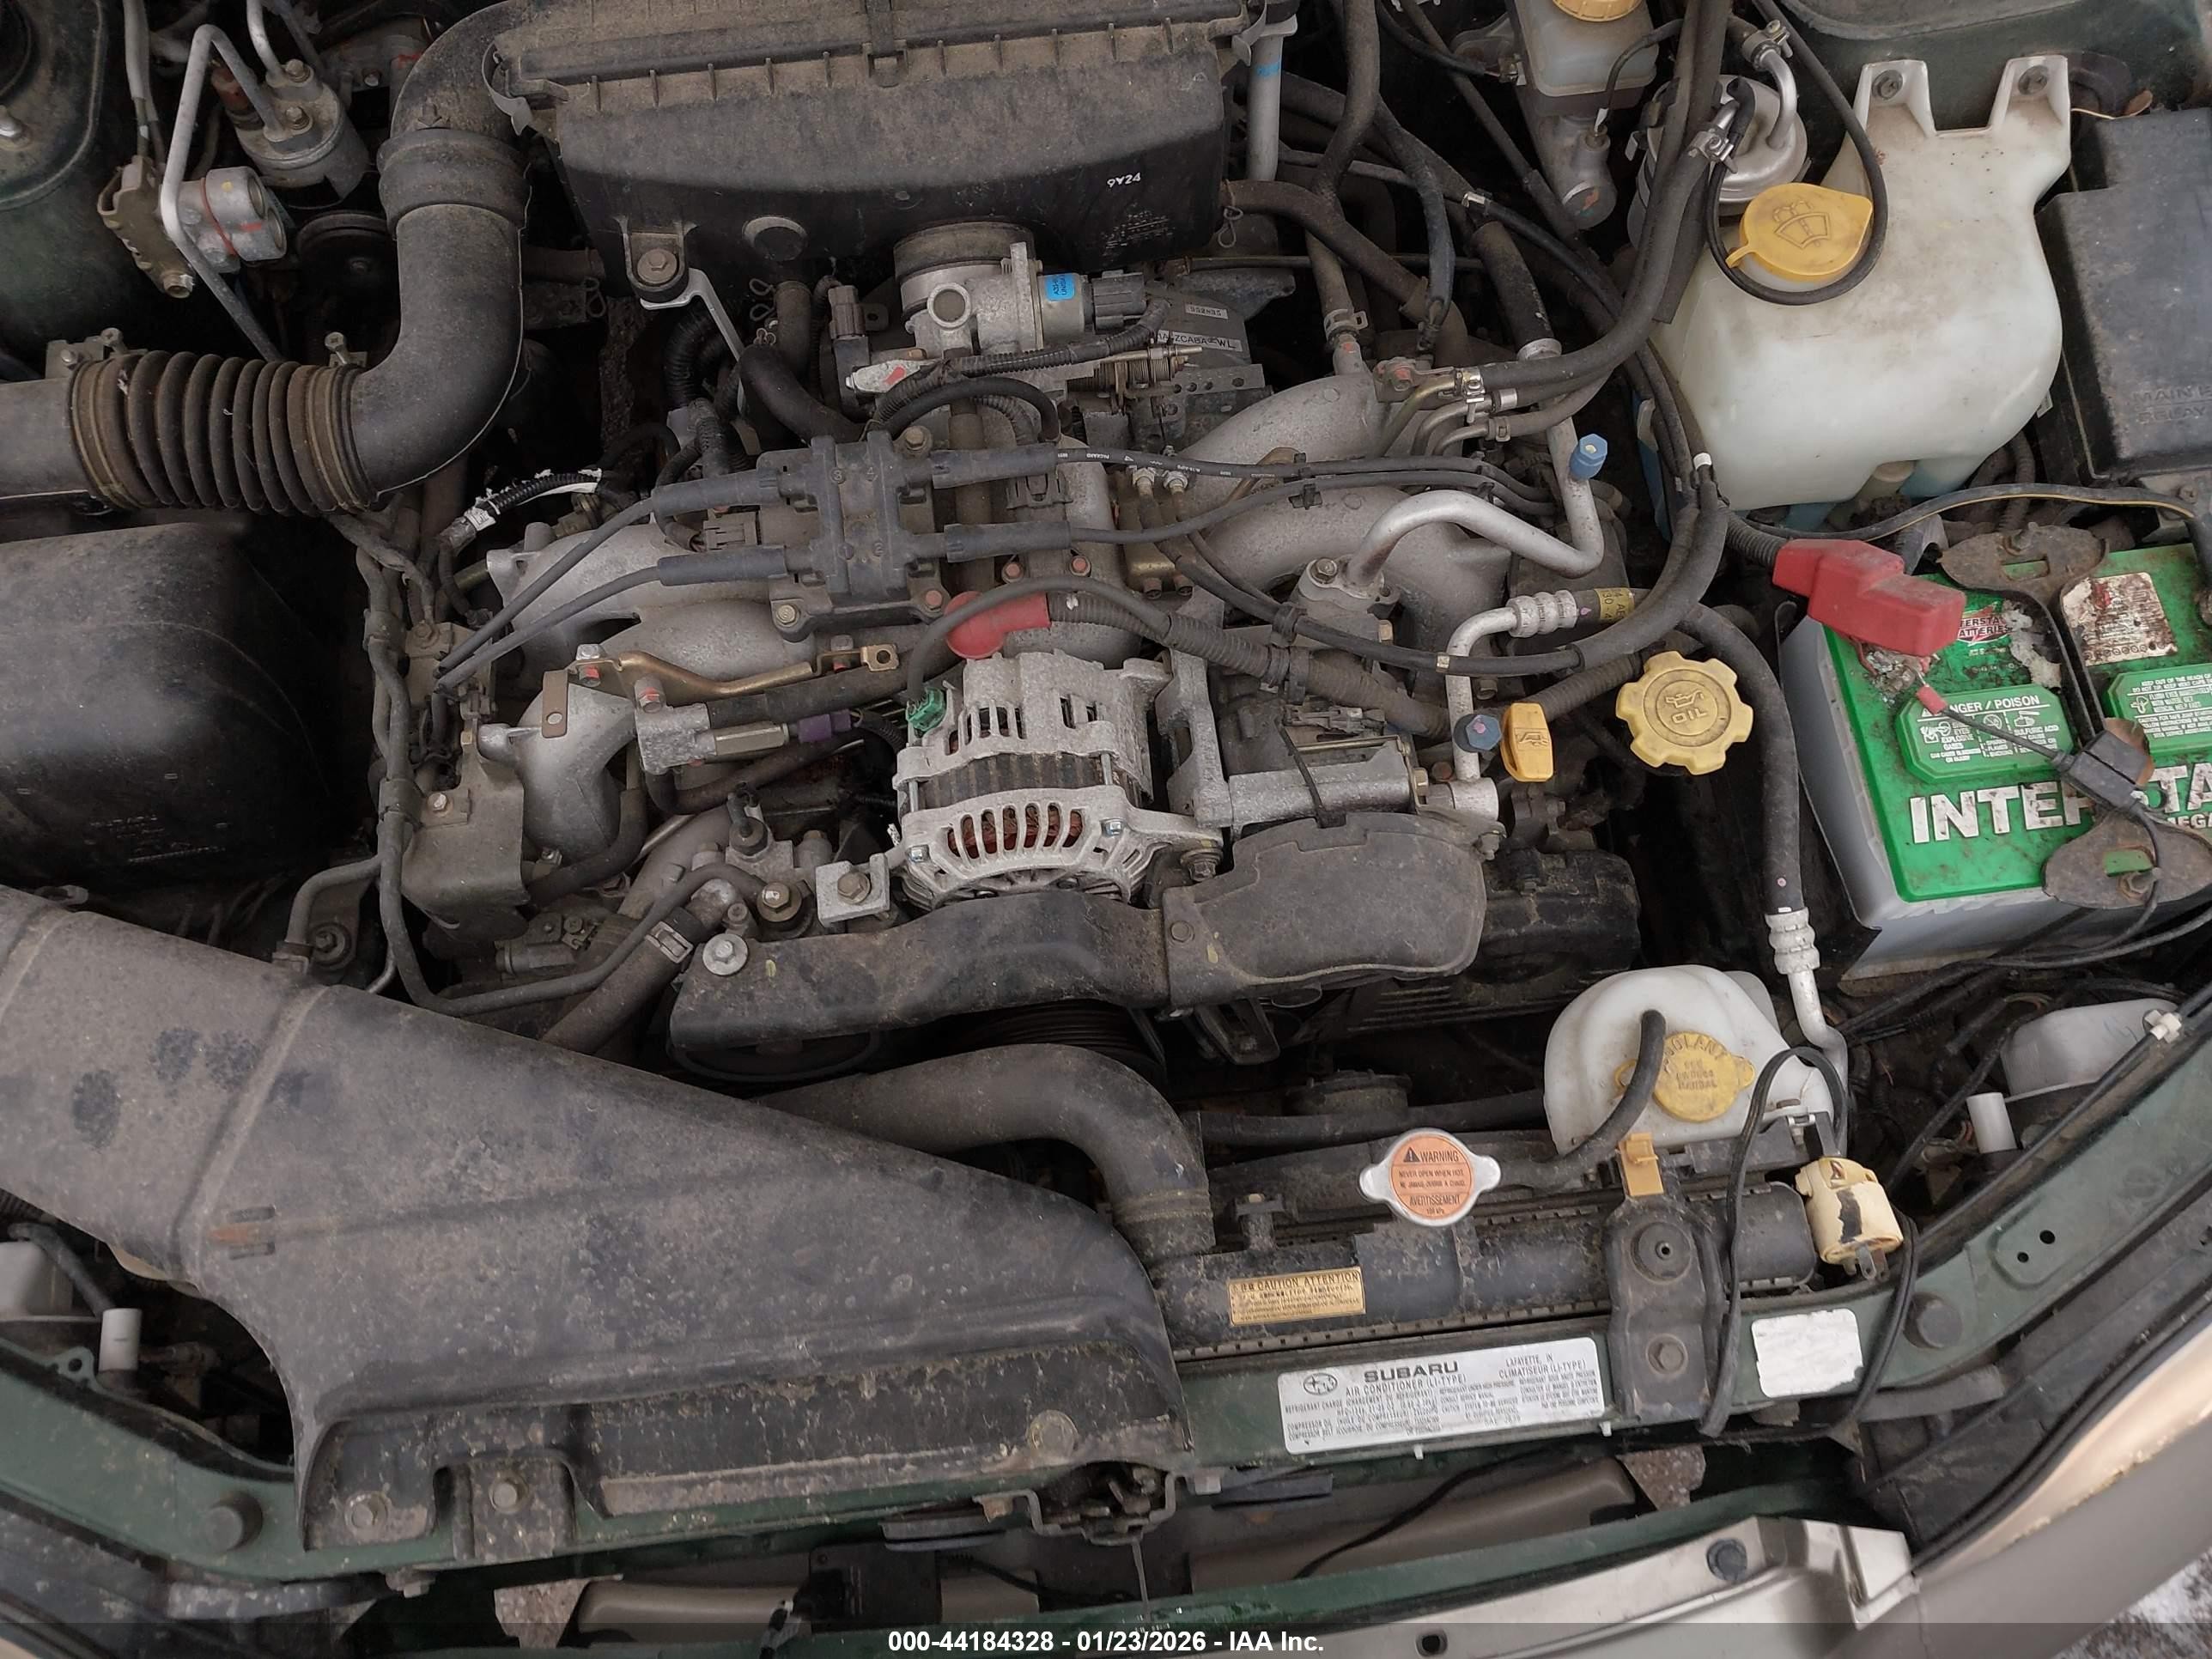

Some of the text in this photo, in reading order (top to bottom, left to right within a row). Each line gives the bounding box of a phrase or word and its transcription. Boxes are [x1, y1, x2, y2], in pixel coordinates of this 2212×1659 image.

[1959, 625, 2014, 638] ATTERIES
[1994, 695, 2040, 710] POISON
[1672, 708, 1707, 724] OIL
[1419, 1150, 1459, 1163] WARNING
[1409, 1194, 1461, 1206] AVERTISSEMENT
[1257, 1277, 1298, 1291] CAUTION
[1304, 1271, 1360, 1286] ATTENTION
[1364, 1360, 1458, 1382] SUBARU
[1346, 1385, 1361, 1397] AIR
[1363, 1376, 1424, 1395] CONDITIONER
